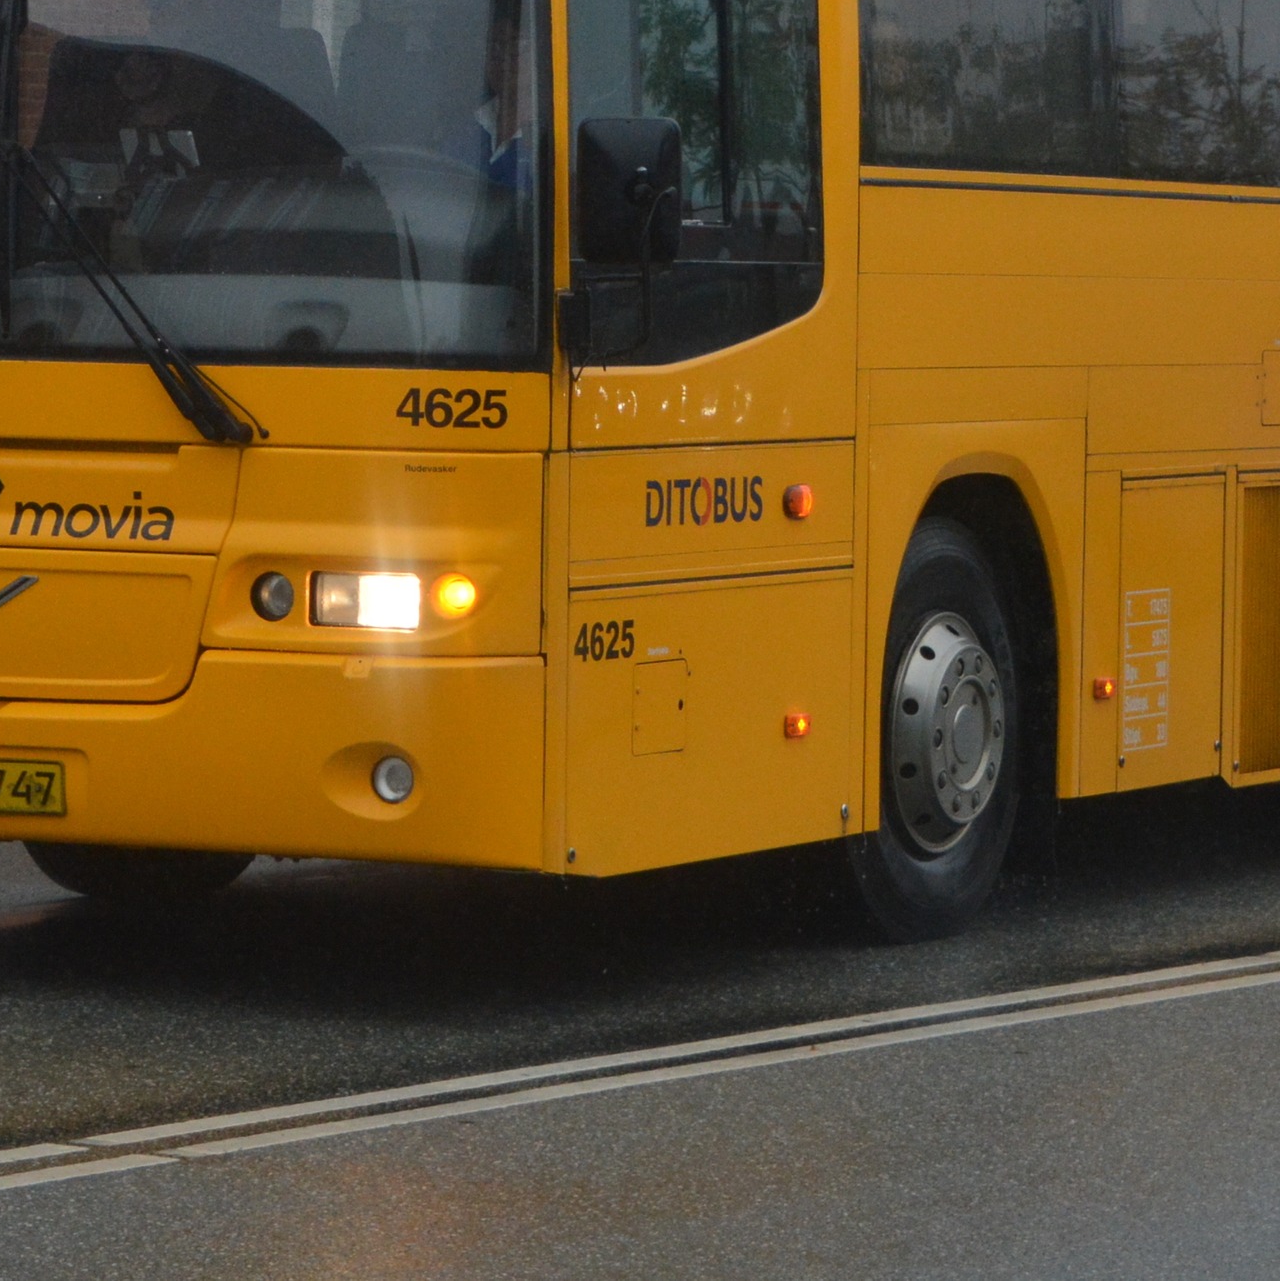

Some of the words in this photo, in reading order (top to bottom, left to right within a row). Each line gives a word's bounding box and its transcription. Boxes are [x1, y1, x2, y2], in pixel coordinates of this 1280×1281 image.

[396, 387, 509, 429] 4625
[9, 491, 176, 542] movia
[645, 475, 764, 527] DITOBUS
[574, 619, 635, 663] 4625
